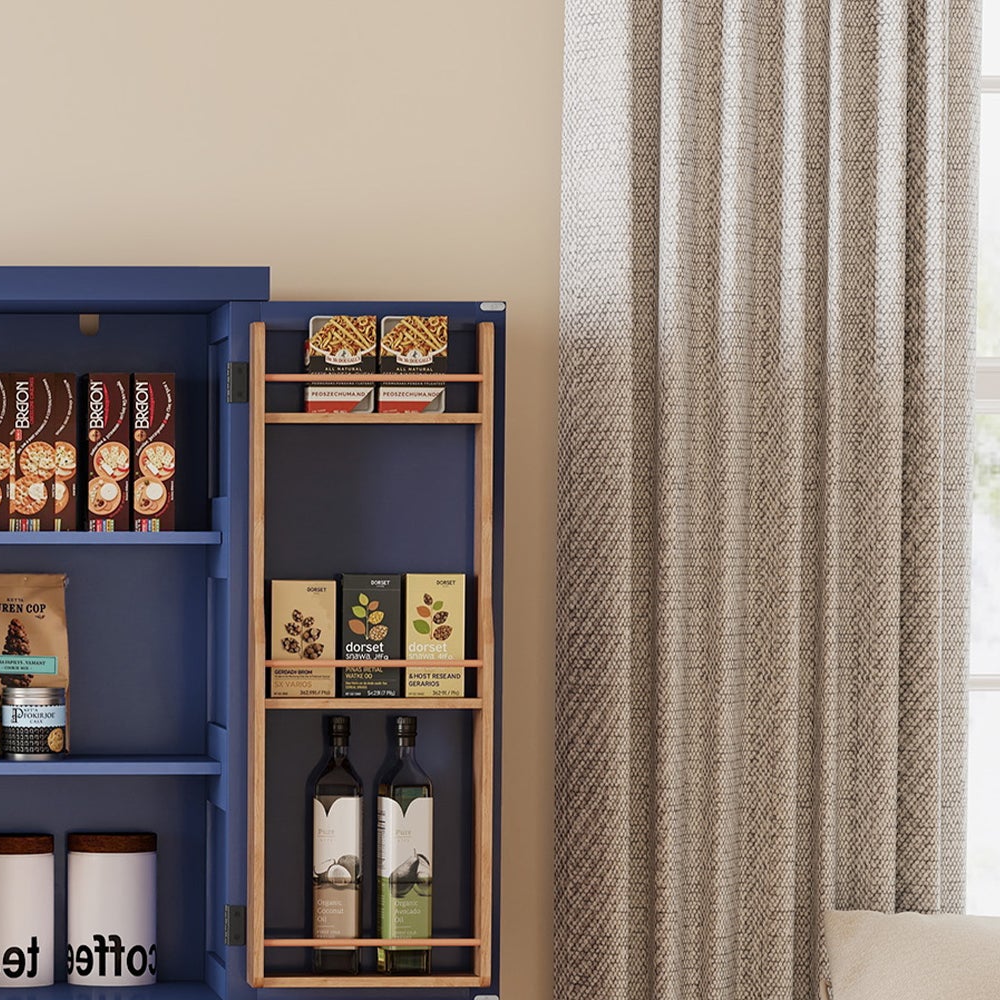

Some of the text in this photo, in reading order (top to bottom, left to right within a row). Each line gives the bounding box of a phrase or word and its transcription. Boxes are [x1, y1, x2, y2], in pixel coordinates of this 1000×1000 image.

[26, 603, 47, 613] COP
[345, 641, 384, 653] dorset
[408, 641, 447, 653] dorset
